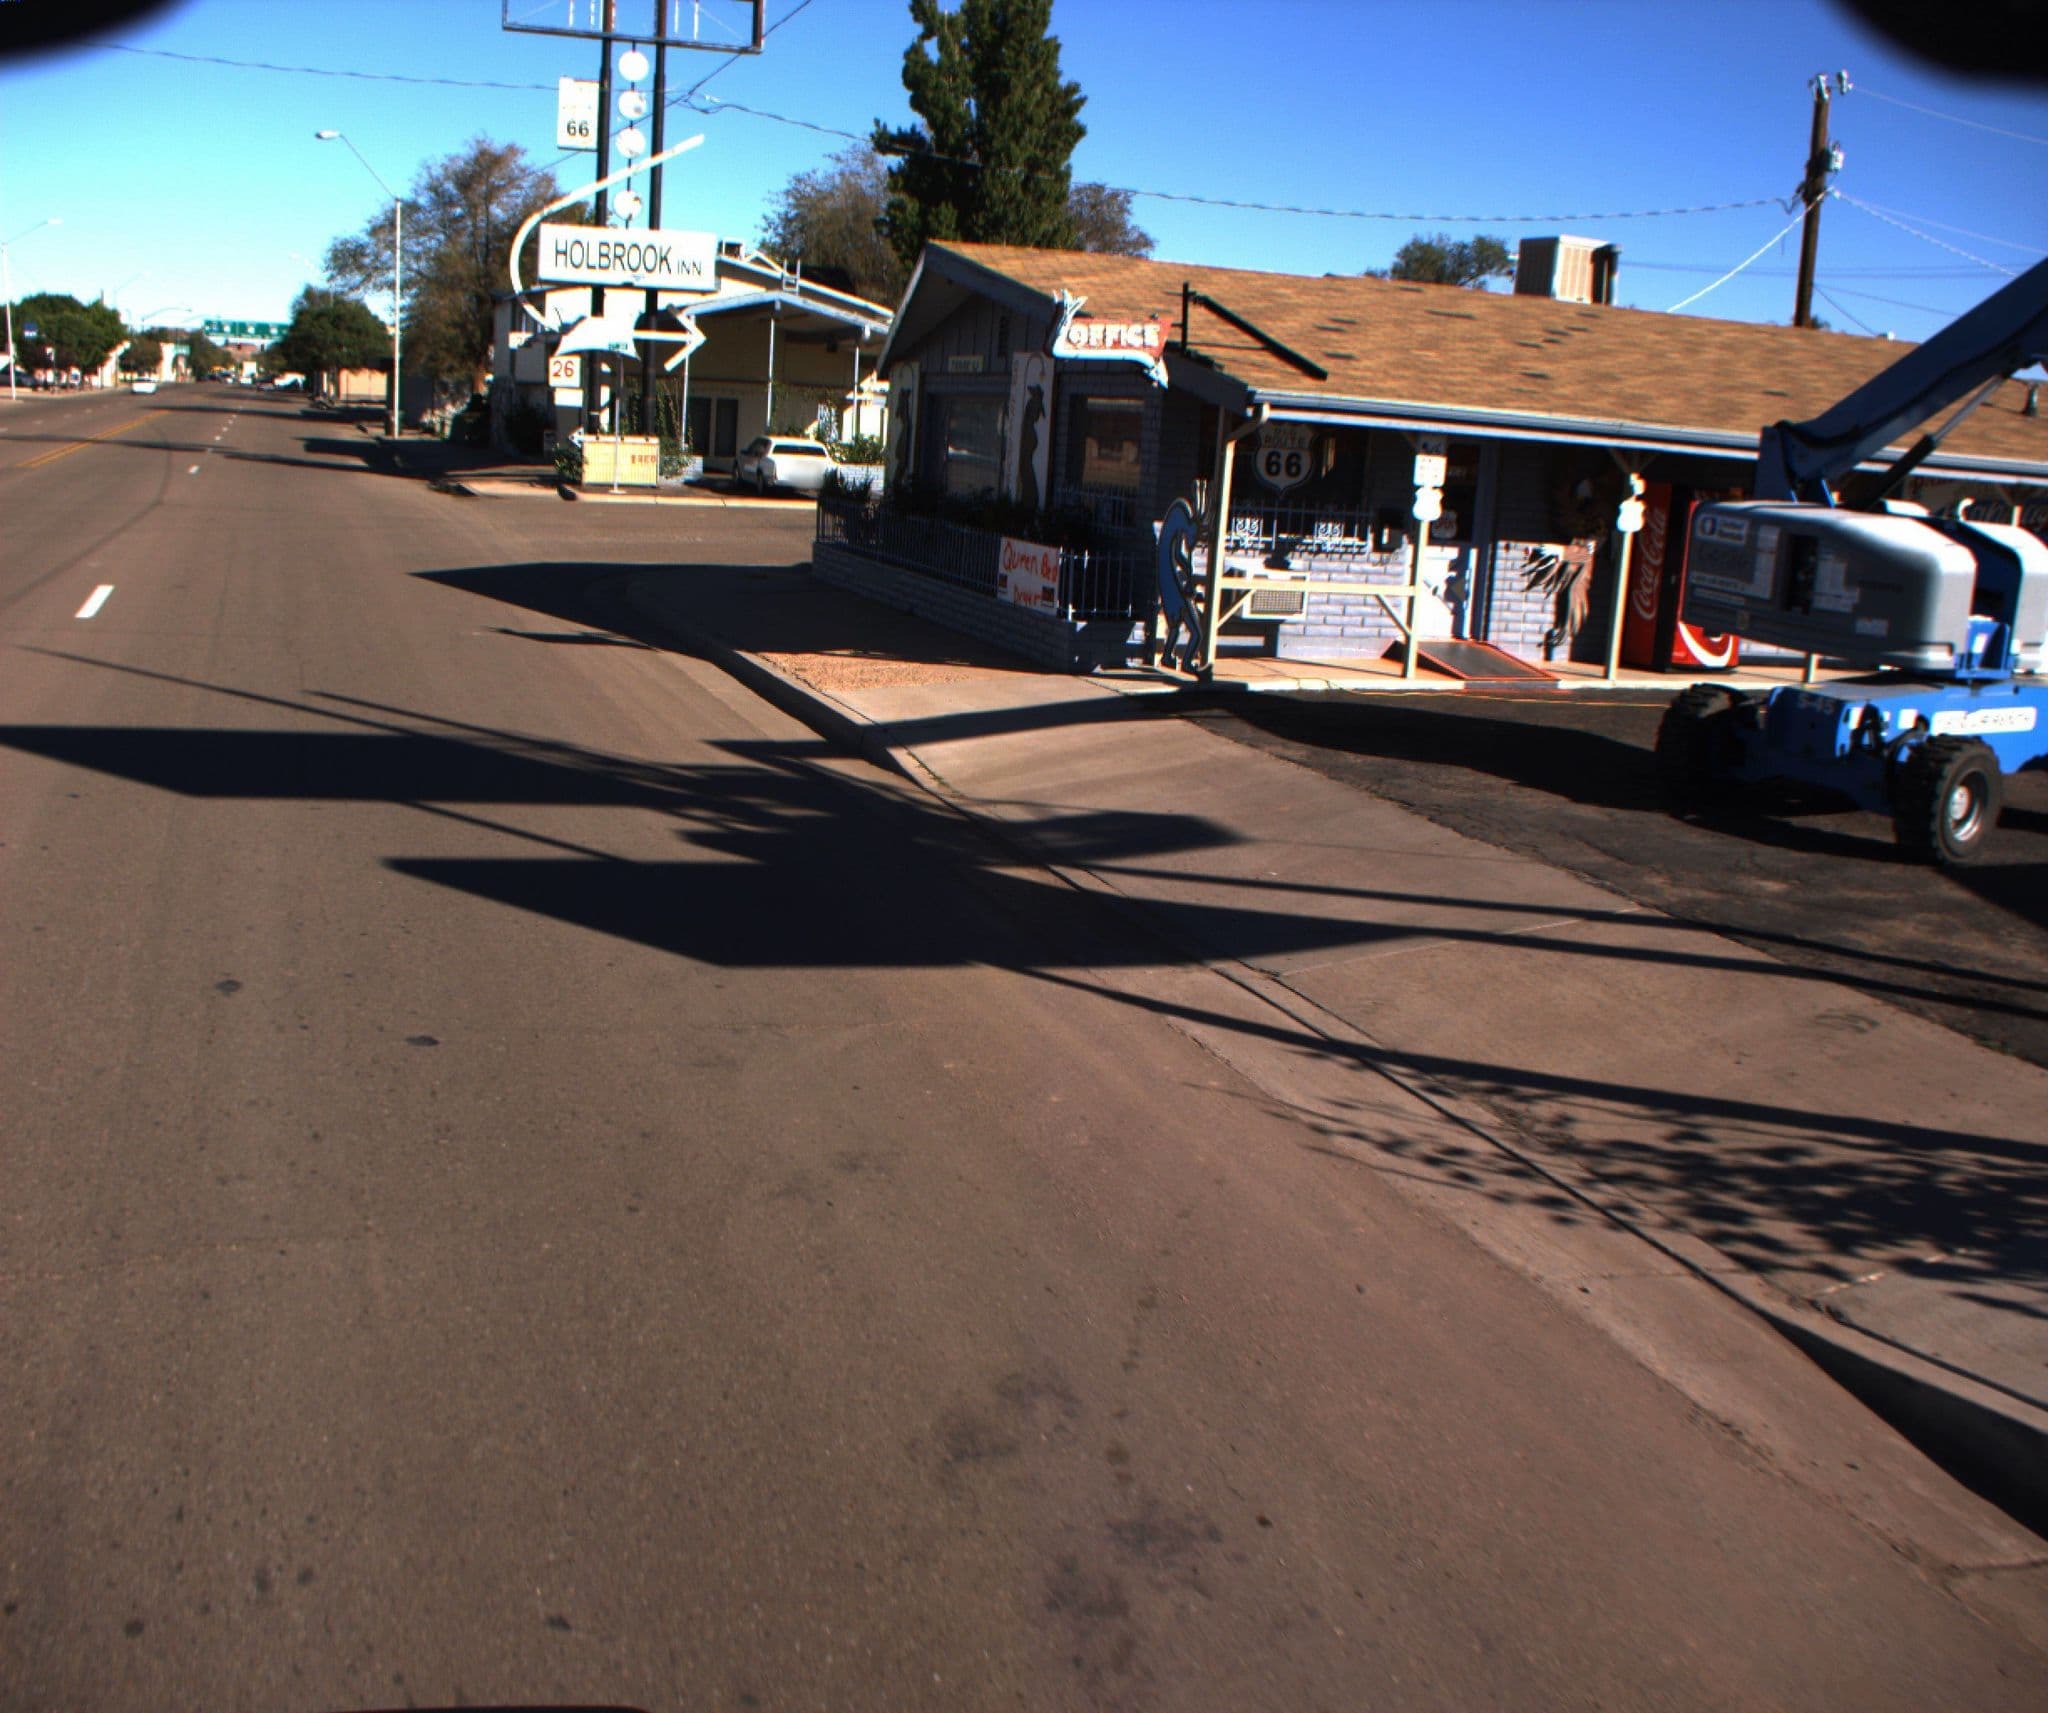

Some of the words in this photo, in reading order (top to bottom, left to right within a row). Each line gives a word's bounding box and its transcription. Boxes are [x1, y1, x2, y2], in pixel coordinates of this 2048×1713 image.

[566, 119, 590, 138] 66
[554, 237, 672, 275] HOLBROOK
[676, 259, 703, 276] INN
[1067, 323, 1160, 347] OFFICE
[552, 360, 575, 378] 26
[1266, 450, 1301, 478] 66
